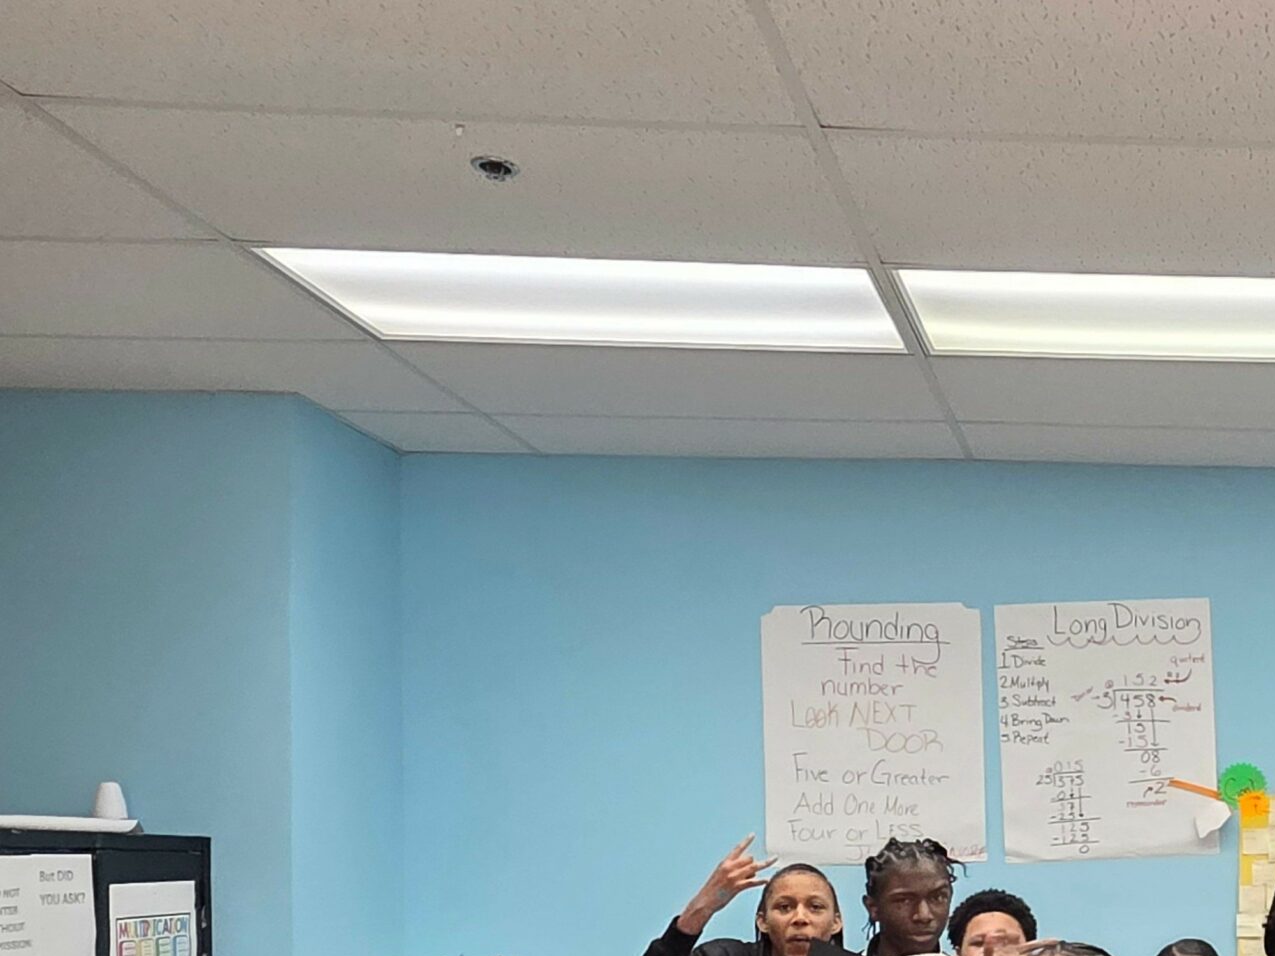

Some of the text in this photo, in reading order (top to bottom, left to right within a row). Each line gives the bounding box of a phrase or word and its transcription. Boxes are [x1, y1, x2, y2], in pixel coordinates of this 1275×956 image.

[1054, 603, 1201, 643] Long Division
[800, 606, 940, 664] Rounding
[836, 647, 937, 677] Find the
[821, 678, 904, 696] number
[1010, 675, 1050, 692] Multiply
[791, 700, 917, 728] Look NEXT
[1011, 712, 1043, 732] Bring
[857, 727, 944, 754] DOOR
[1012, 730, 1050, 745] Repeat
[793, 753, 950, 786] Five or Greater
[793, 792, 919, 816] Add One More
[787, 819, 837, 841] Four
[846, 828, 869, 841] or
[39, 870, 74, 882] But DID
[40, 892, 86, 906] YOU ASK?
[119, 917, 188, 938] MULTIPLICATION
